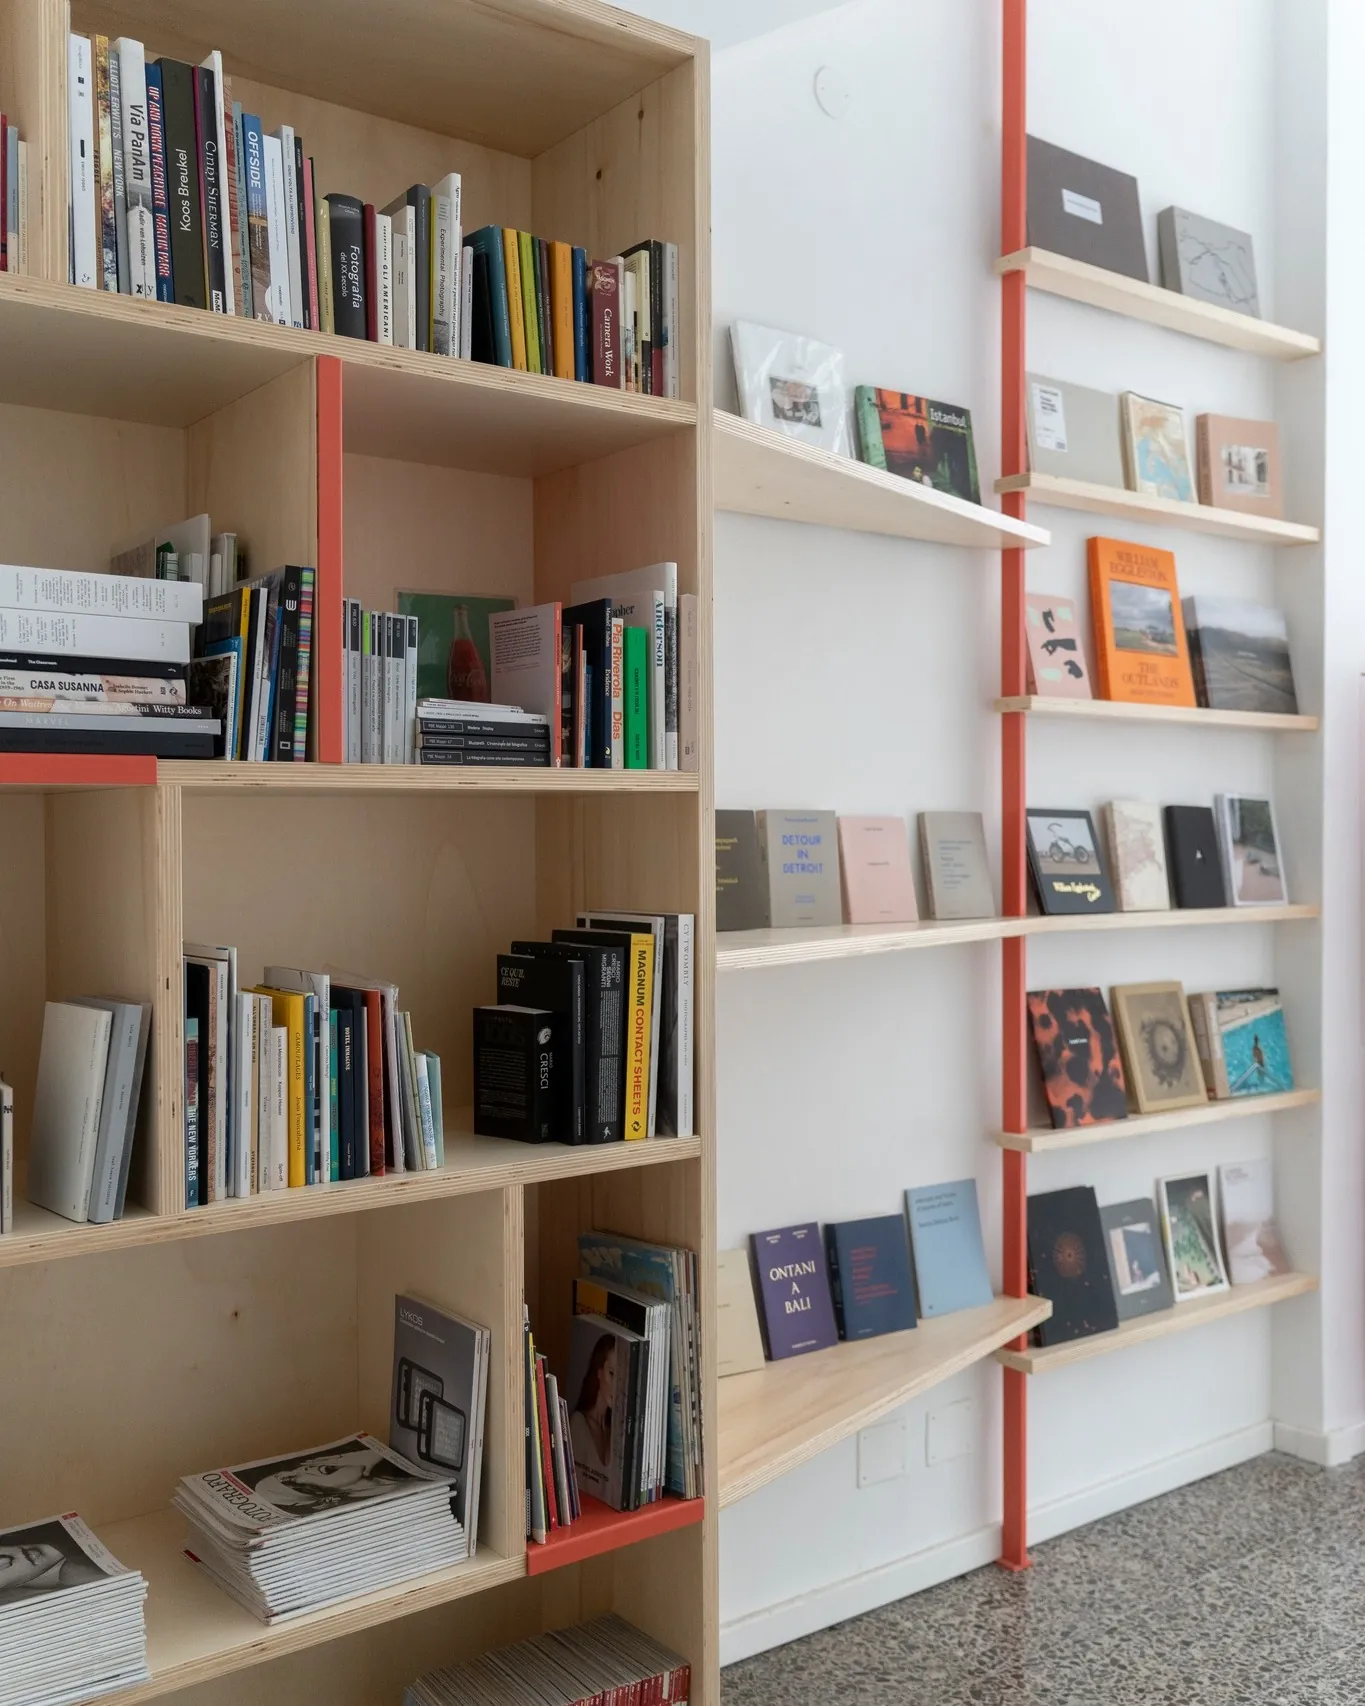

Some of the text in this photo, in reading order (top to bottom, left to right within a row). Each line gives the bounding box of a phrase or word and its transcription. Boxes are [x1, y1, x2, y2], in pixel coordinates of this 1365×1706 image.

[110, 60, 124, 197] ELLIOTT ERWITT'S NEW YORK
[130, 104, 145, 180] Vía PanAm
[149, 87, 165, 207] UP AND DOWN PEACHTREE
[248, 131, 261, 188] OFFSIDE
[176, 149, 191, 232] Koos Breukel
[156, 214, 169, 276] MARTIN PARR
[341, 264, 347, 274] XX
[348, 245, 362, 308] Fotografia
[604, 308, 614, 376] Camera Work
[930, 408, 967, 428] Istanbul
[1116, 550, 1159, 569] WILLIAM
[612, 624, 622, 698] Pia Riverola
[1138, 662, 1160, 675] THE
[30, 680, 56, 690] CASA
[58, 681, 104, 692] SUSANNA
[1122, 674, 1179, 689] OUTLANDS
[4, 698, 17, 707] On
[153, 705, 176, 715] Witty
[178, 706, 202, 715] Books
[613, 712, 622, 740] Días
[782, 835, 821, 846] DETOUR
[797, 850, 808, 860] IN
[783, 863, 823, 874] DETROIT
[684, 924, 689, 936] CY
[501, 967, 509, 976] CE
[502, 978, 520, 988] RESTE
[632, 950, 647, 1115] MAGNUM CONTACT SHEETS
[540, 1053, 549, 1090] CRESCI
[188, 1108, 196, 1123] THE
[188, 1125, 196, 1142] NEW
[188, 1145, 196, 1181] YORKERS
[770, 1260, 816, 1282] ONTANI
[791, 1281, 800, 1295] A
[785, 1297, 811, 1314] BALI
[400, 1308, 423, 1326] LYKOS
